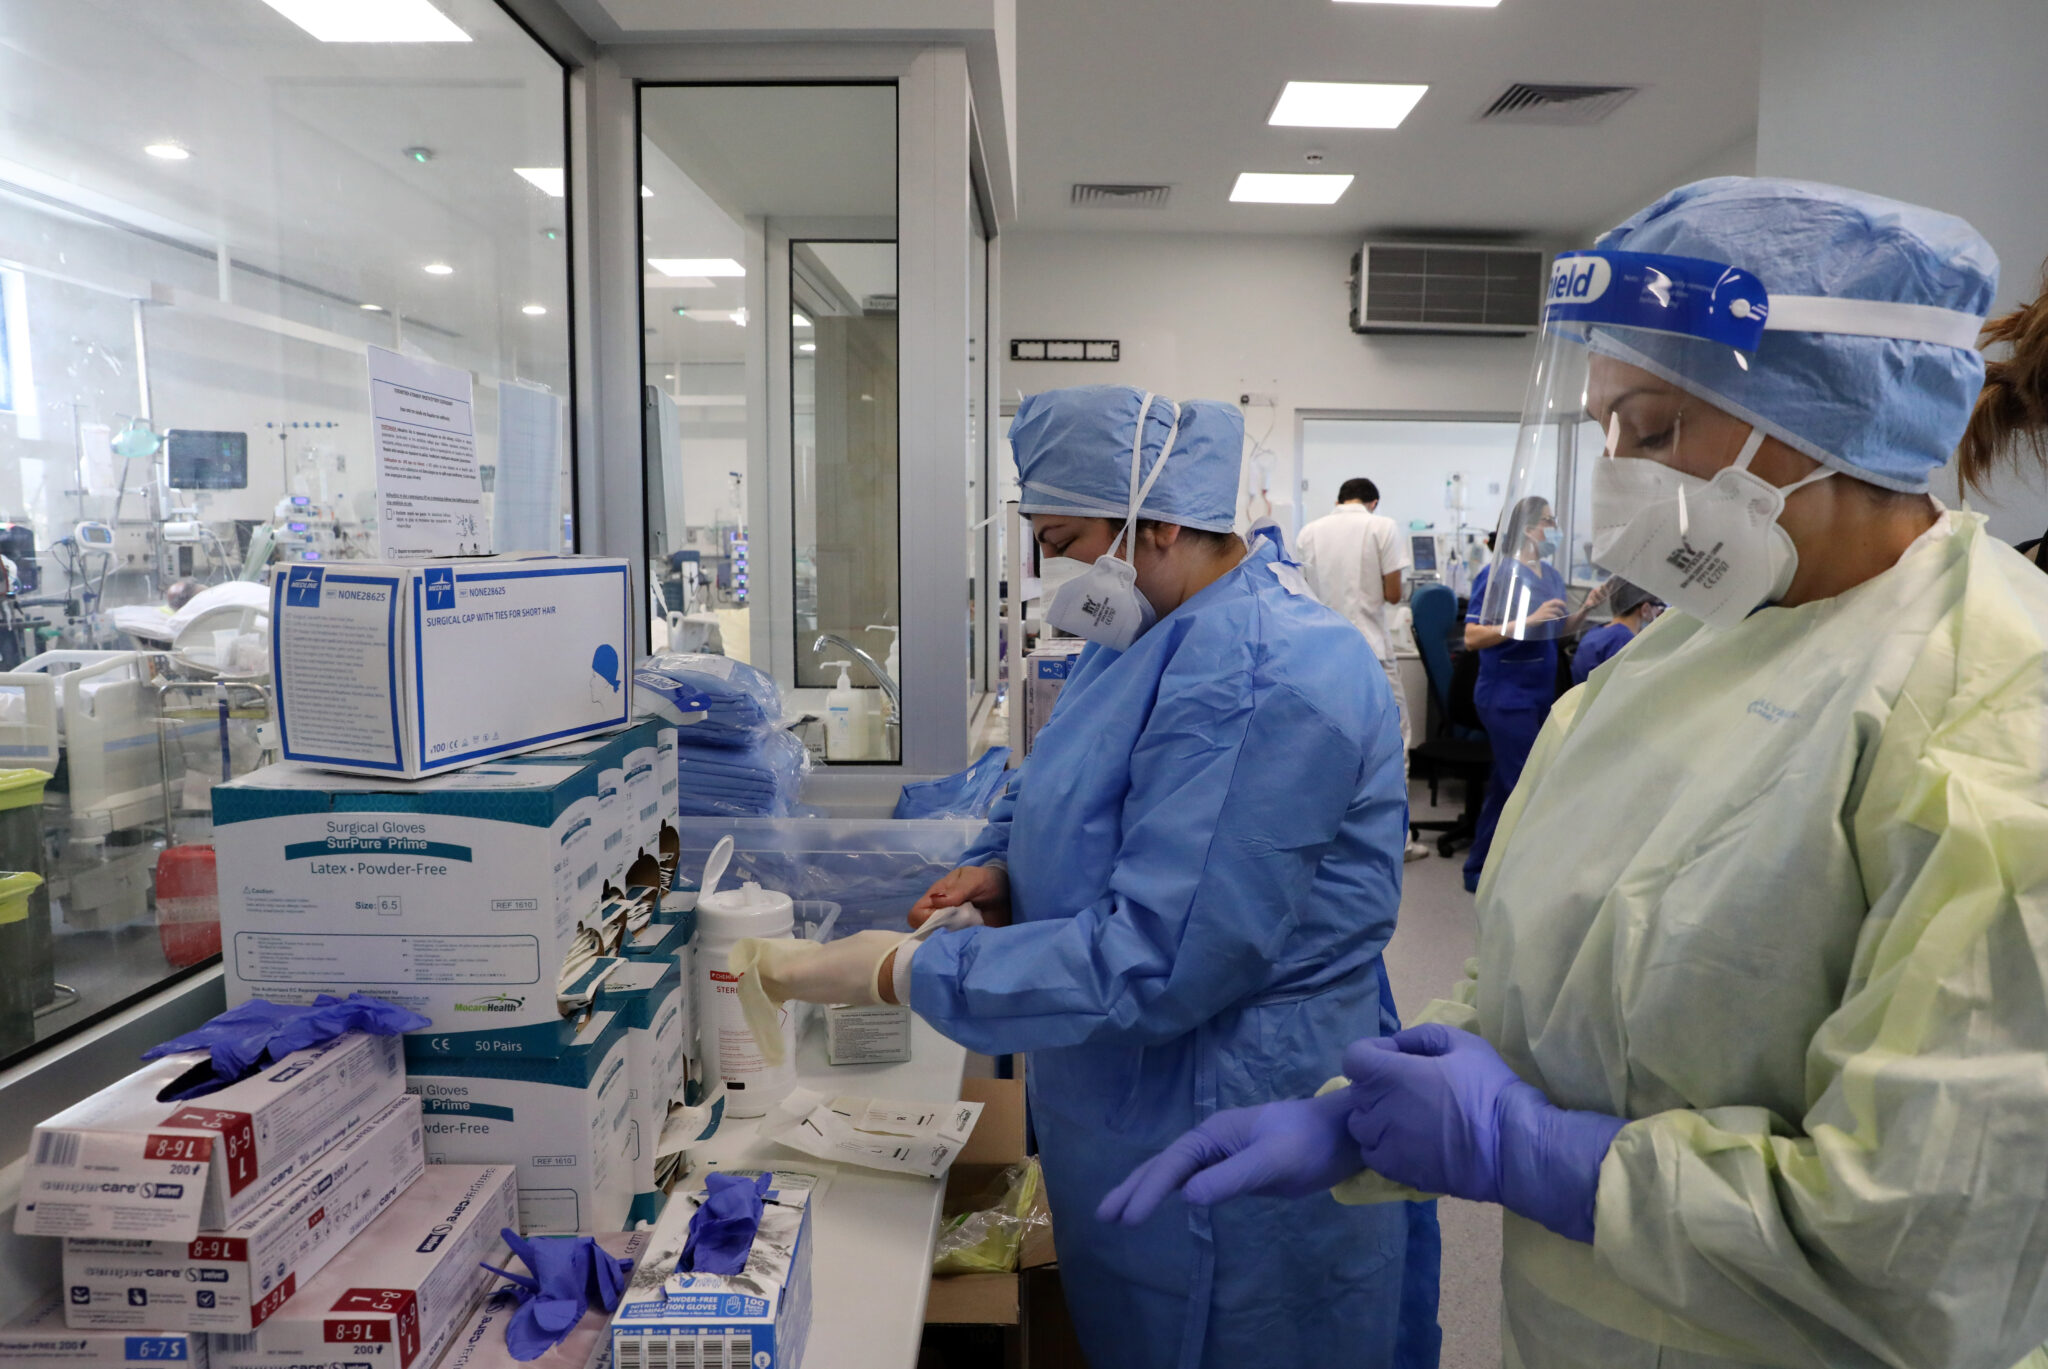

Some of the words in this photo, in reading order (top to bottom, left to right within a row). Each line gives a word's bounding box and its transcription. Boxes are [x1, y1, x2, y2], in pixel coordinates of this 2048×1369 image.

[426, 615, 461, 627] SURGICAL
[462, 613, 476, 623] CAP
[476, 612, 494, 621] WITH
[494, 611, 508, 620] TIES
[509, 609, 521, 618] FOR
[522, 607, 541, 617] SHORT
[542, 606, 556, 614] HAIR
[326, 821, 379, 835] Surgical
[382, 821, 426, 833] Gloves
[327, 837, 382, 850] SurPure
[388, 838, 428, 850] Prime
[310, 863, 347, 875] Latex
[358, 864, 447, 876] Powder-Free
[355, 901, 376, 909] Size:
[381, 901, 398, 910] 6.5
[496, 901, 513, 910] REF
[515, 901, 533, 909] 1610
[432, 1038, 450, 1050] CE
[475, 1041, 490, 1051] 50
[494, 1041, 522, 1052] Pairs
[427, 1085, 468, 1095] Gloves
[433, 1100, 470, 1110] Prime
[424, 1123, 489, 1134] wder-Free
[156, 1139, 184, 1157] 8-9
[230, 1127, 250, 1158] 8-9
[537, 1157, 552, 1165] REF
[554, 1157, 572, 1165] 1610
[169, 1164, 191, 1175] 200
[194, 1243, 219, 1257] 8-9
[261, 1294, 279, 1319] 8-9
[744, 1297, 765, 1306] 100
[336, 1324, 361, 1340] 8-9
[59, 1341, 78, 1350] 200
[140, 1342, 167, 1357] 6-7
[170, 1342, 180, 1357] S
[353, 1345, 374, 1354] 200
